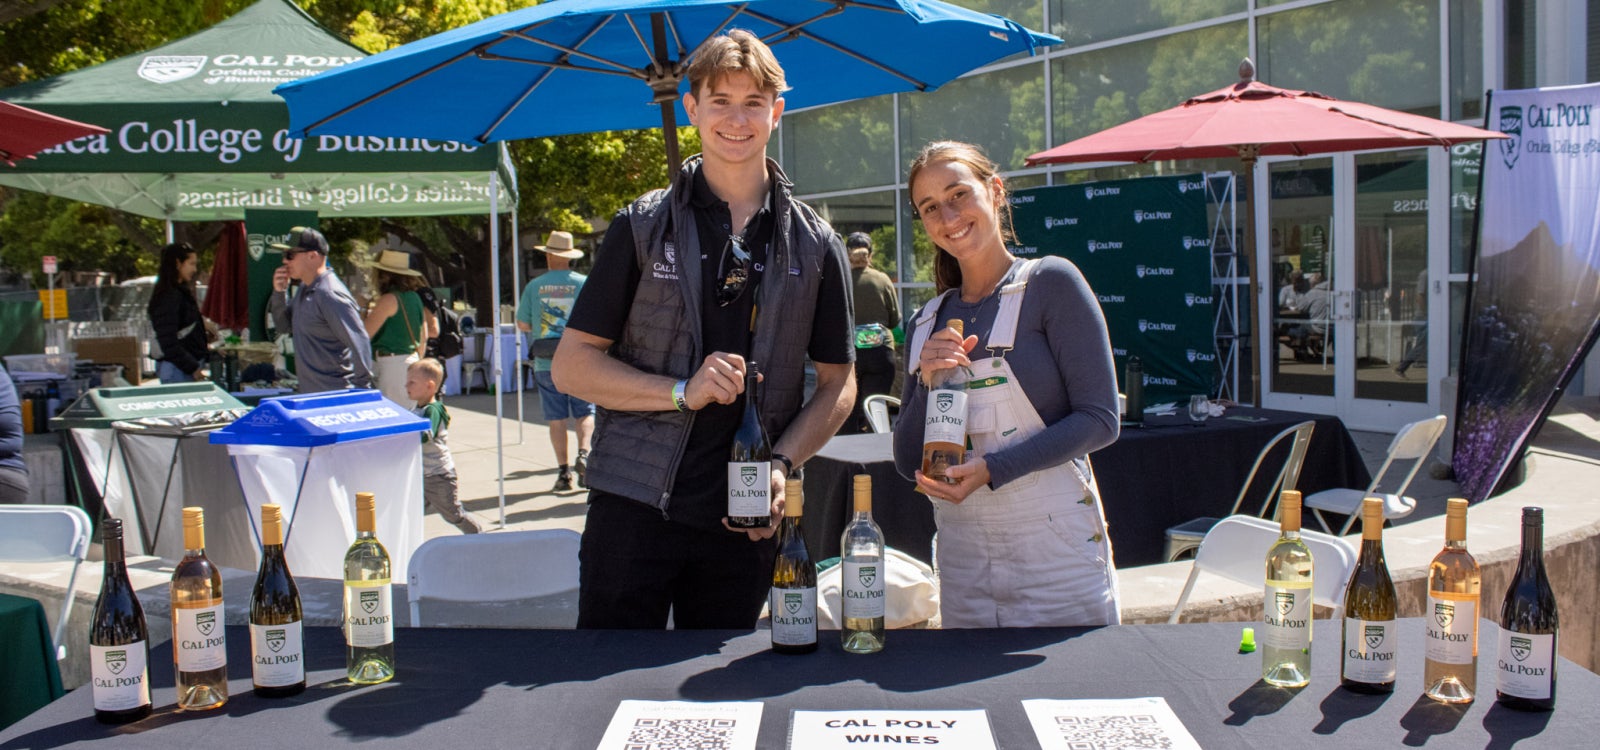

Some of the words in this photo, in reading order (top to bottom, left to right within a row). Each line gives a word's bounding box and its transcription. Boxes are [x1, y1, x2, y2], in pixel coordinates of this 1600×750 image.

[213, 54, 278, 66] CAL
[1528, 104, 1554, 128] CAL
[1557, 103, 1592, 127] POLY
[119, 119, 260, 164] College
[653, 262, 671, 272] CAL
[118, 396, 224, 411] COMPOSTABLES
[307, 406, 400, 427] RECYCLABLES
[941, 415, 963, 426] POLY
[731, 489, 746, 497] CAL
[847, 589, 865, 599] CAL
[349, 616, 368, 626] CAL
[369, 614, 390, 625] POLY
[774, 615, 792, 625] CAL
[792, 616, 814, 625] POLY
[1265, 614, 1280, 627] CAL
[1282, 619, 1307, 628] POLY
[1442, 631, 1469, 642] POLY
[182, 640, 204, 650] CAL
[255, 655, 274, 665] CAL
[275, 653, 300, 664] POLY
[1349, 649, 1370, 660] CAL
[1372, 651, 1394, 661] POLY
[1498, 659, 1516, 673] CAL
[1517, 665, 1546, 676] POLY
[94, 677, 114, 688] CAL
[116, 675, 143, 687] POLY
[825, 719, 877, 728] CAL
[885, 720, 957, 728] POLY
[846, 734, 939, 744] WINES
